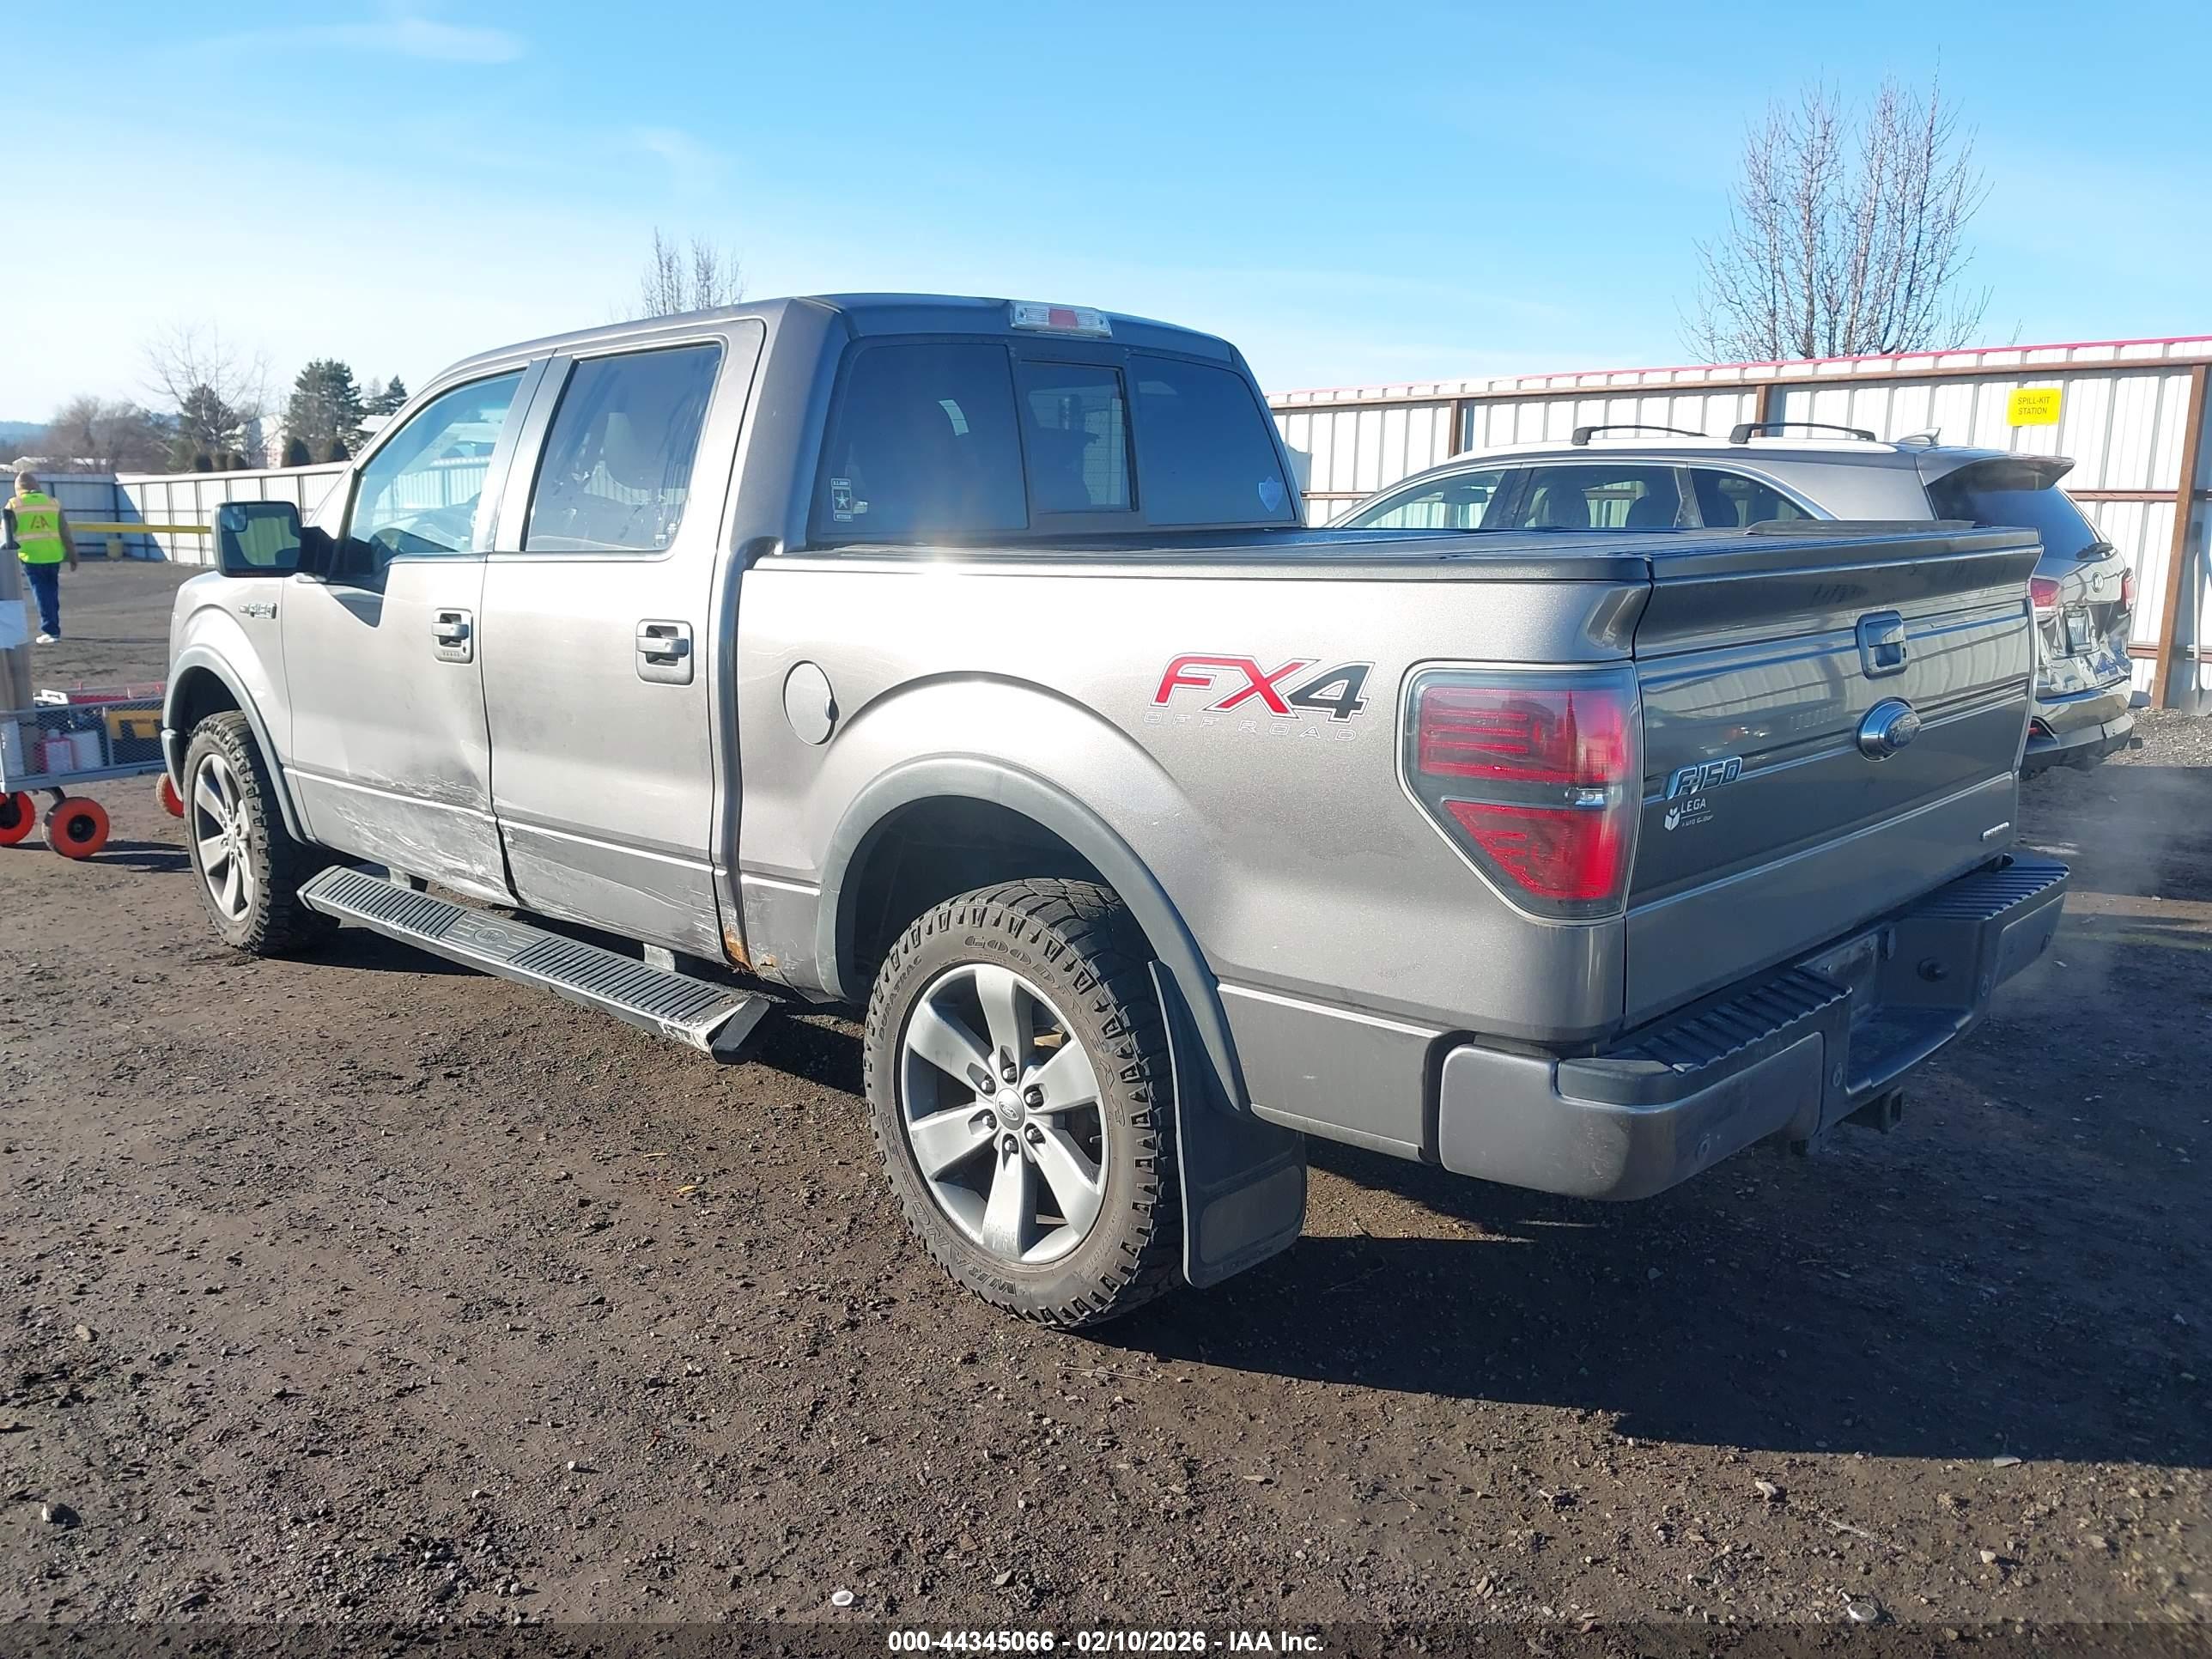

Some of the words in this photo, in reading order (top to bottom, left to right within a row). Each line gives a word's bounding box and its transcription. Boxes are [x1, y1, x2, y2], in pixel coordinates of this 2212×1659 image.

[1149, 651, 1376, 725] FX4
[1143, 712, 1220, 729] OFF
[1237, 720, 1358, 742] ROAD
[1681, 799, 1706, 813] LEGA
